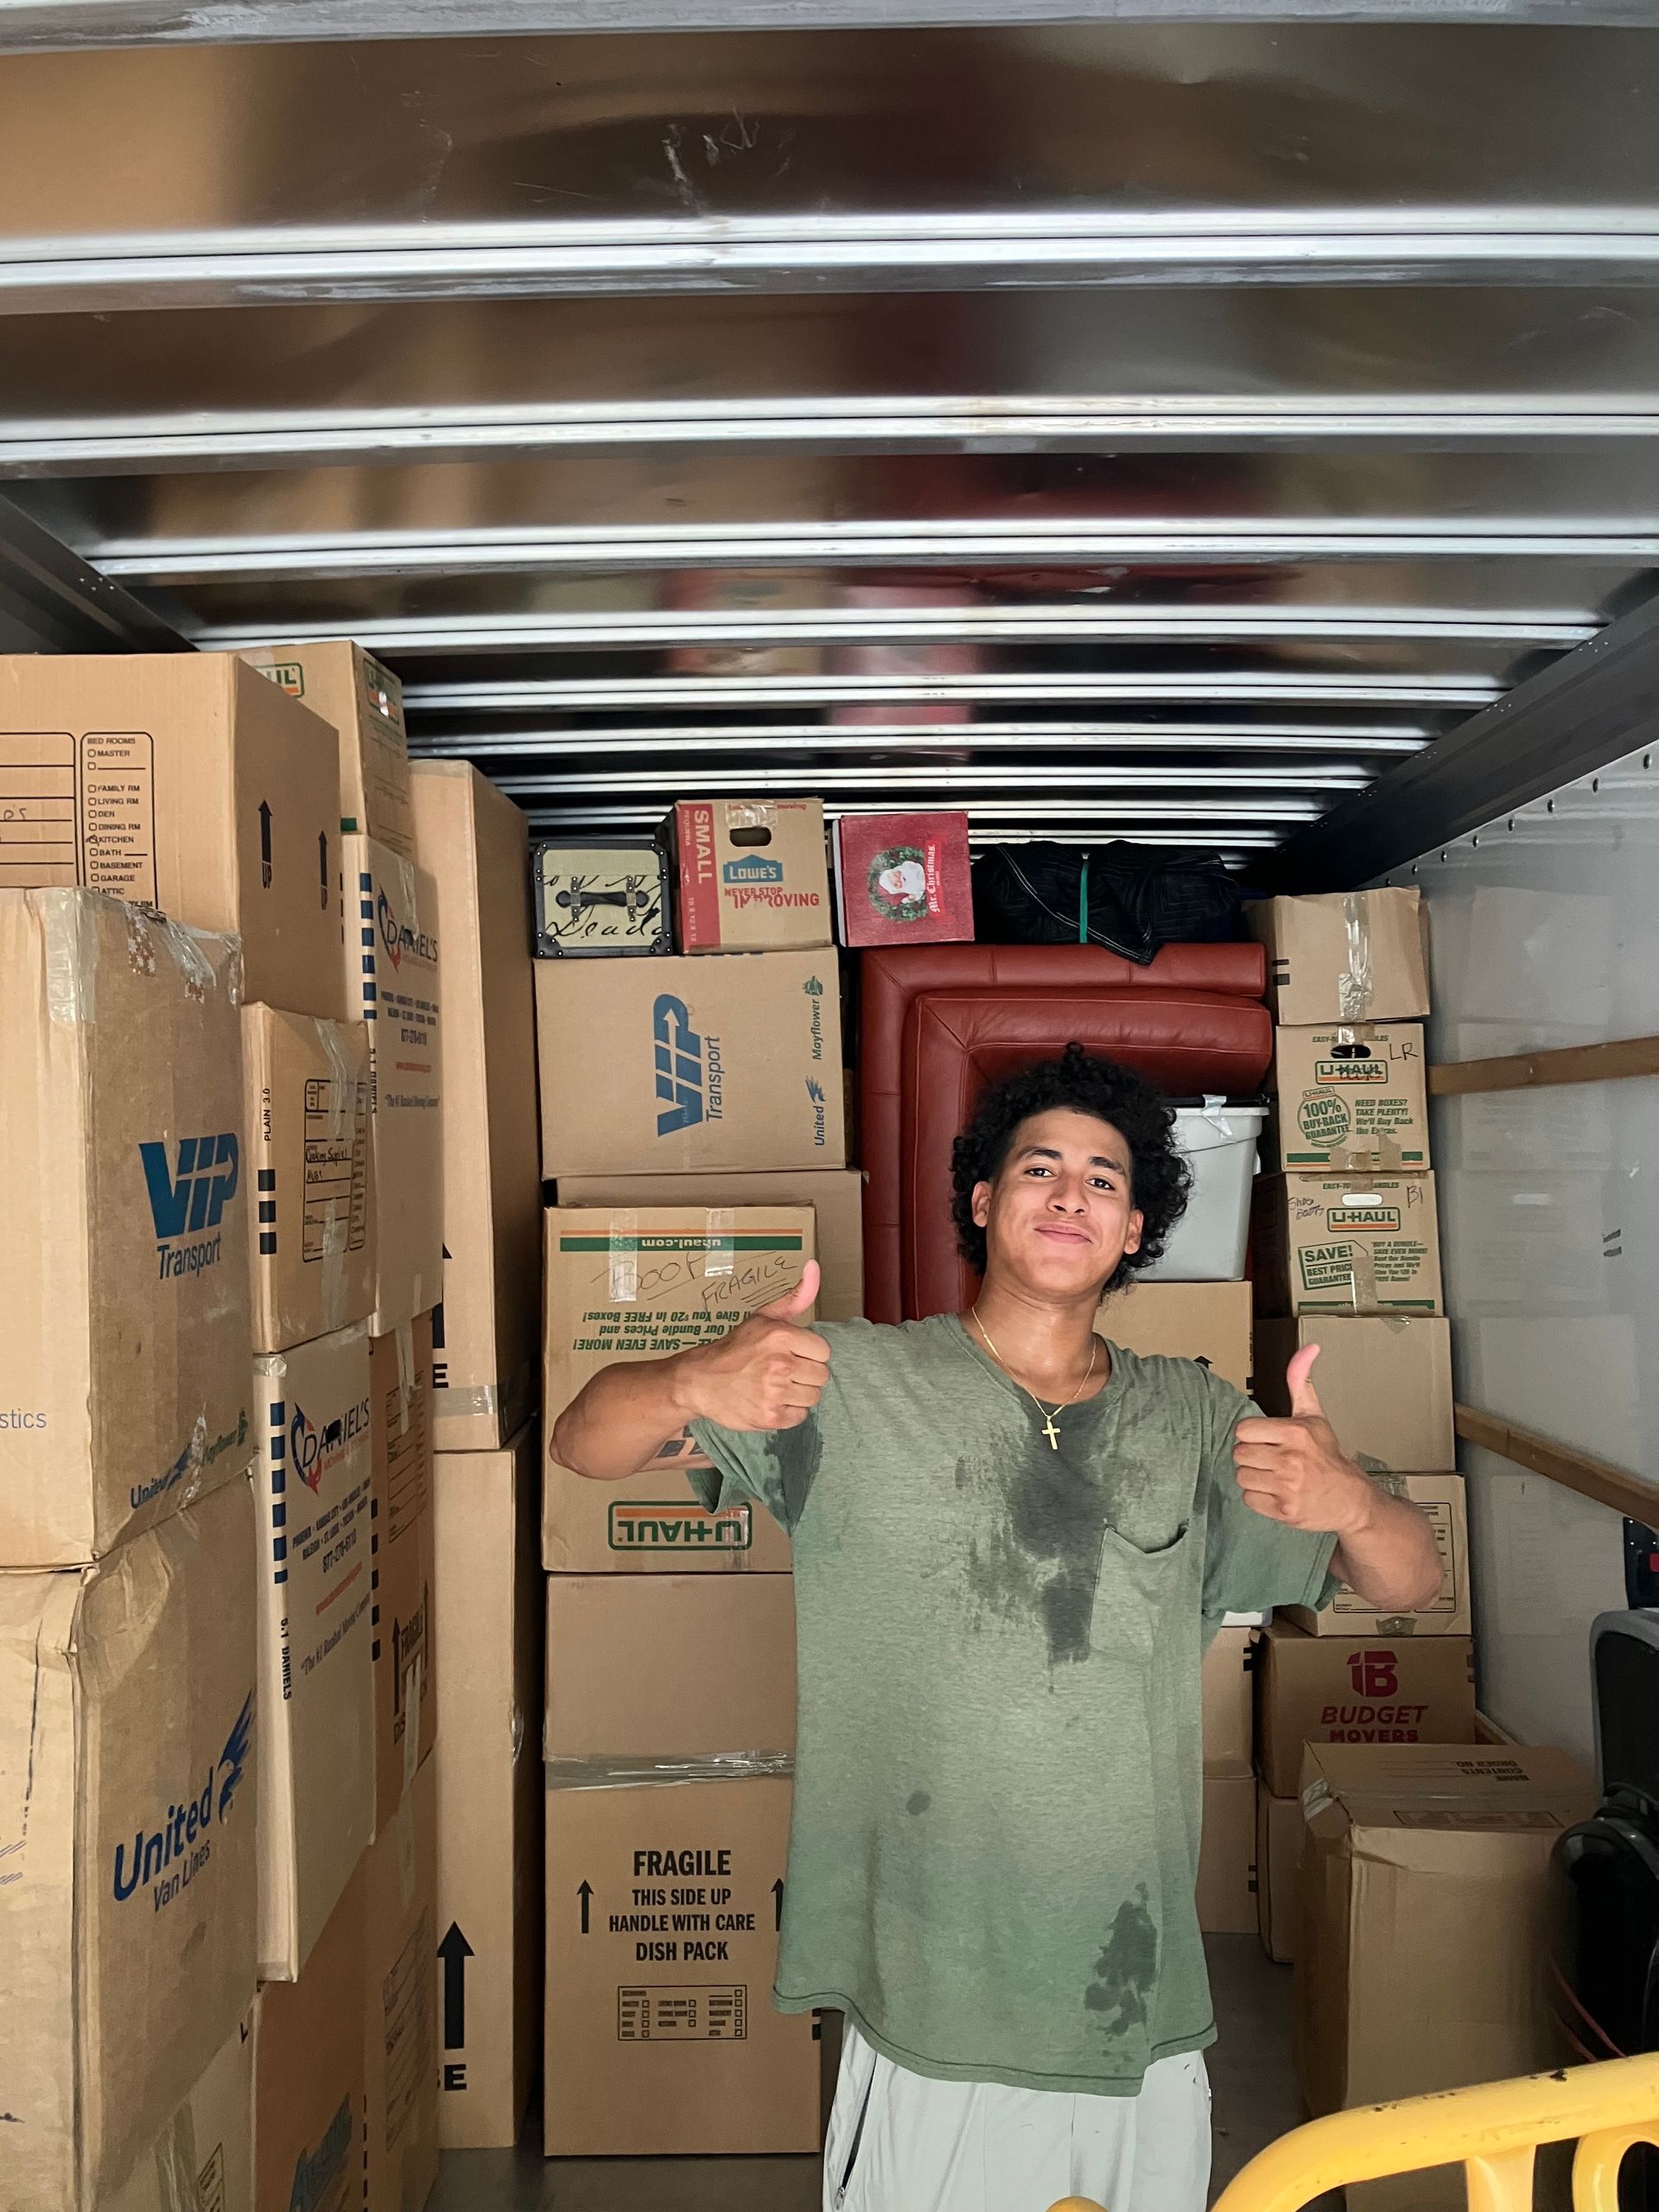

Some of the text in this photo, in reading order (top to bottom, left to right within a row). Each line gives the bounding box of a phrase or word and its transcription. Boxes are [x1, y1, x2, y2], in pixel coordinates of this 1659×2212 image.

[694, 810, 713, 885] SMALL
[262, 864, 272, 889] UP
[728, 865, 778, 880] LOWE'S
[724, 886, 783, 897] NEVER STOP
[810, 999, 823, 1060] Mayflower
[1389, 1042, 1419, 1061] LR
[704, 1036, 725, 1122] Transport
[263, 1087, 272, 1141] PLAIN 3.0
[1303, 1098, 1342, 1118] 100%
[813, 1105, 825, 1146] United
[1303, 1113, 1348, 1130] BUY-BACK
[1377, 1117, 1392, 1126] Buy
[1332, 1211, 1395, 1223] U-HAUL
[641, 1238, 721, 1249] uhaul.com
[156, 1232, 222, 1281] Transport
[1304, 1244, 1353, 1262] SAVE!
[1306, 1266, 1328, 1277] BEST
[702, 1255, 798, 1313] FRAGILE
[582, 1311, 620, 1323] Boxes!
[625, 1311, 653, 1322] FREE
[656, 1311, 667, 1322] in
[671, 1311, 690, 1322] $20
[692, 1311, 712, 1322] You
[715, 1311, 741, 1322] Give
[599, 1325, 624, 1336] and
[625, 1325, 659, 1336] Prices
[662, 1325, 702, 1336] Bundle
[703, 1325, 725, 1336] Our
[573, 1338, 613, 1350] MORE!
[615, 1338, 647, 1350] EVEN
[617, 1520, 742, 1542] U-HAUL
[281, 1646, 292, 1700] DANIELS
[1320, 1705, 1428, 1725] BUDGET
[1329, 1729, 1419, 1743] MOVERS
[114, 1765, 214, 1901] United
[633, 1849, 732, 1877] FRAGILE
[154, 1840, 211, 1914] Van Lines
[632, 1888, 732, 1906] THIS SIDE UP
[609, 1913, 755, 1932] HANDLE WITH CARE
[636, 1942, 728, 1961] DISH PACK
